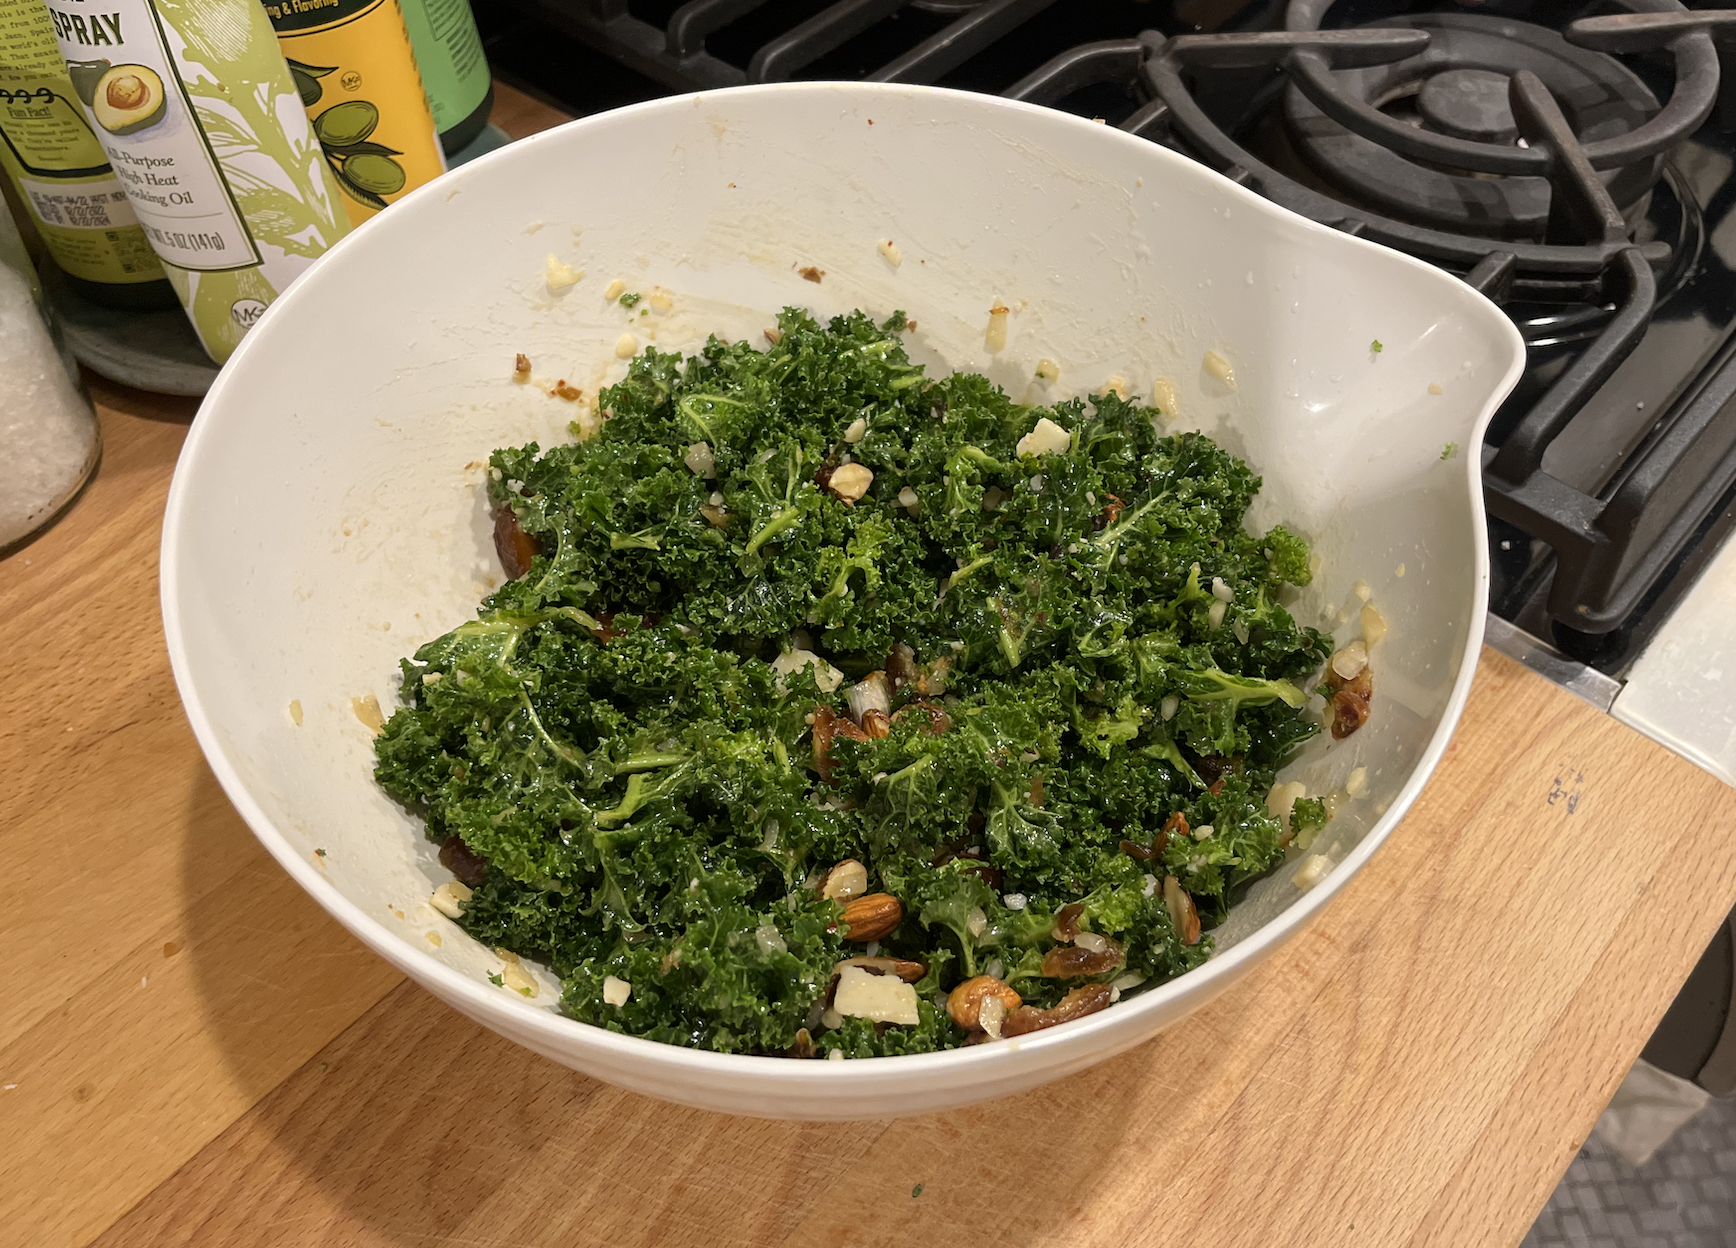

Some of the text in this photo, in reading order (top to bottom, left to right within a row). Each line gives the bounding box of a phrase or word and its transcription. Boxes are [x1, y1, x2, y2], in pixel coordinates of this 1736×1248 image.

[282, 2, 292, 15] &
[292, 0, 339, 13] Flavoring
[50, 7, 124, 46] SPRAY
[6, 105, 52, 117] Fun Fact!
[107, 147, 175, 169] All-Purpose
[117, 166, 179, 186] High Heat
[123, 183, 194, 207] Cooking Oil
[188, 231, 225, 252] (141g)
